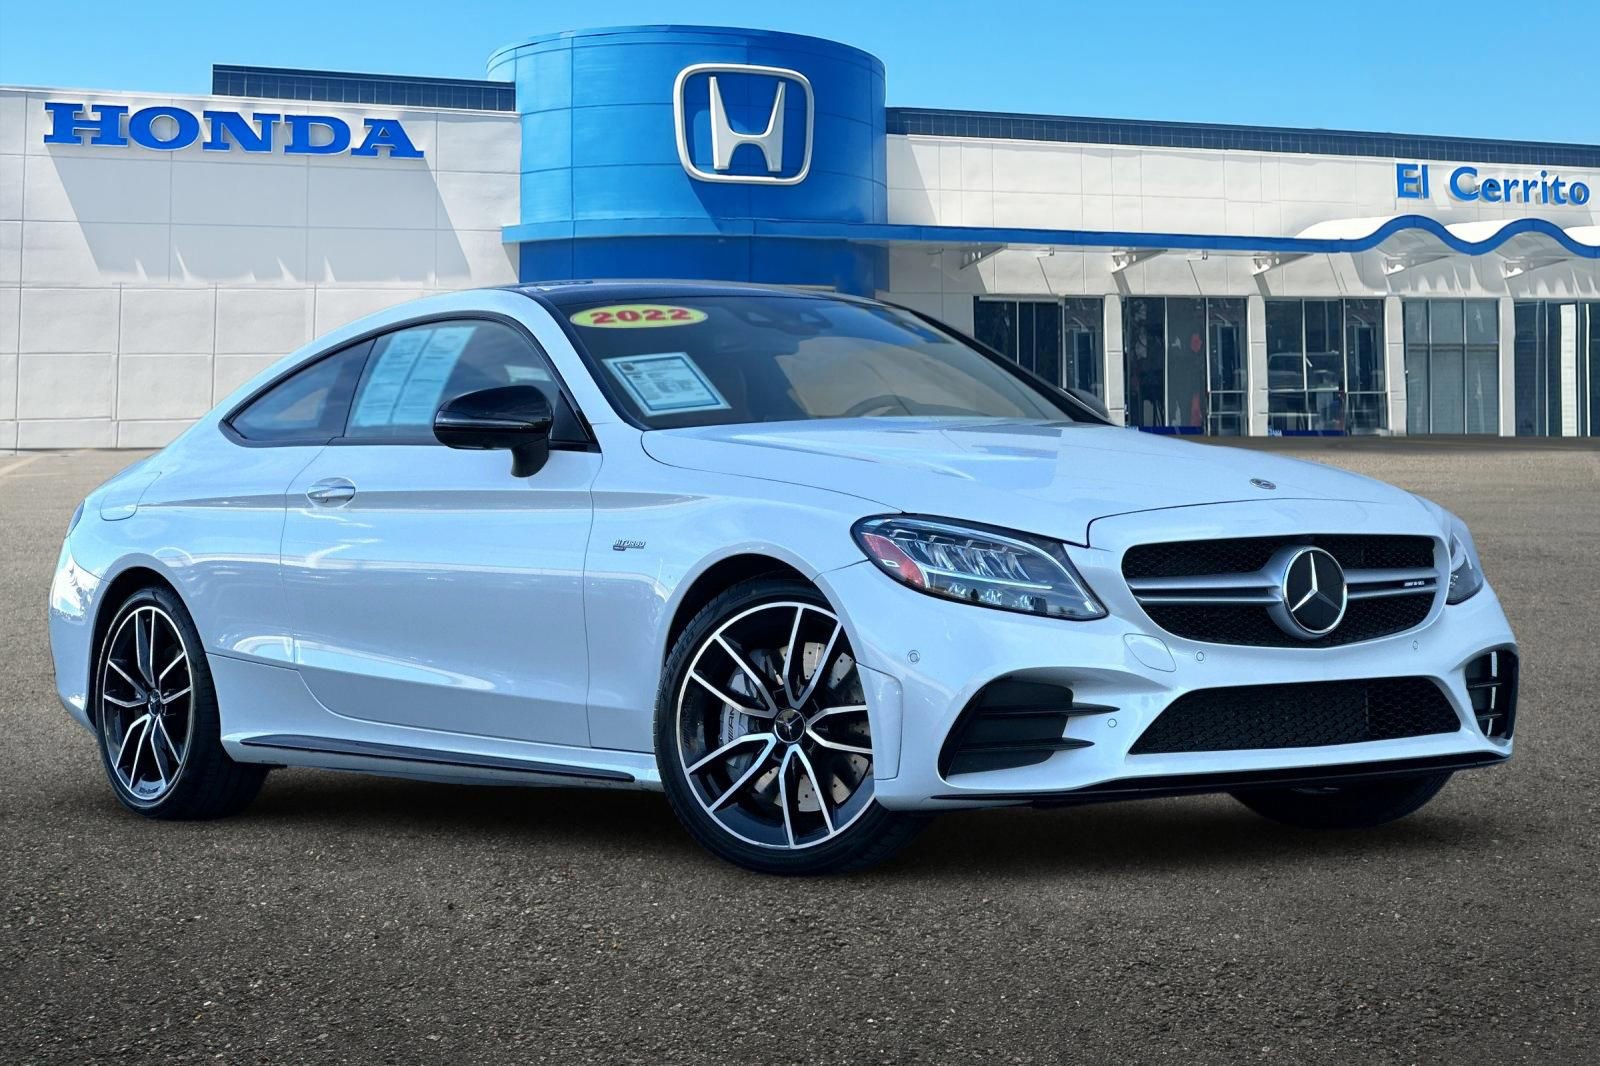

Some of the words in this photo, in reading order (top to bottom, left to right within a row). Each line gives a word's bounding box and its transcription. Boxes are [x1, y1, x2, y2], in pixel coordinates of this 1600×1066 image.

[43, 101, 425, 159] HONDA
[1395, 163, 1429, 199] El
[1449, 166, 1591, 206] Cerrito
[590, 308, 693, 325] 2022
